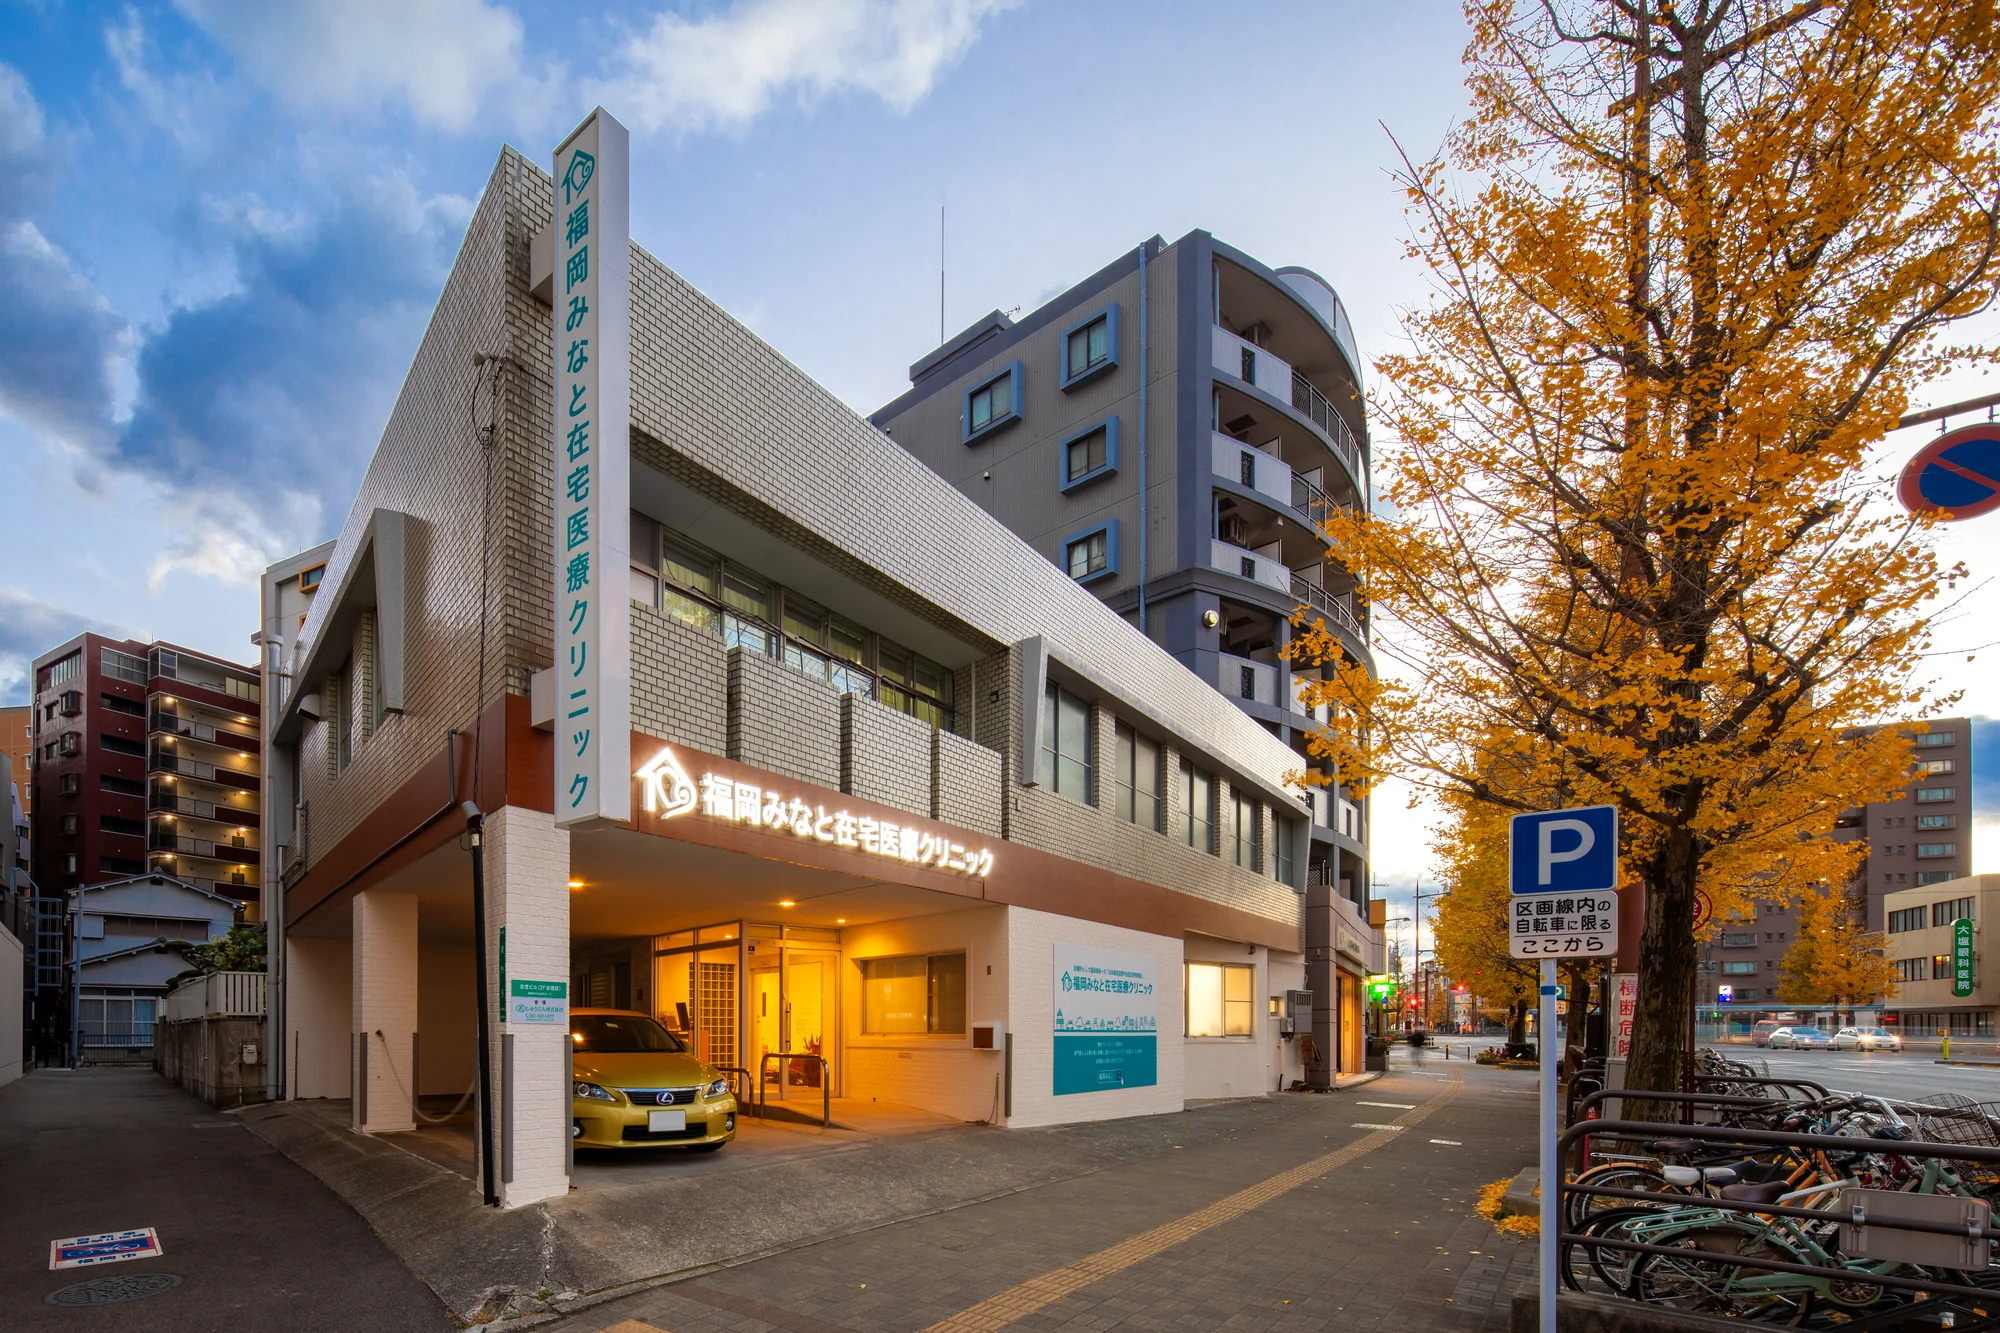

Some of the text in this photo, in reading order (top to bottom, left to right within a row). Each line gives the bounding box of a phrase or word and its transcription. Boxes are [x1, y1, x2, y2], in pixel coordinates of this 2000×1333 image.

[565, 198, 590, 809] 福岡みなと在宅医療クリニック
[700, 772, 994, 878] 福岡みなと在宅医療クリニック
[1538, 818, 1595, 885] P
[1516, 897, 1611, 916] 区画線内の
[1516, 915, 1611, 933] 自転車に限る
[1522, 936, 1604, 954] ここから
[1957, 925, 1970, 990] 大塩眼科医院
[1073, 975, 1153, 995] 福岡みなと在宅医療クリニック
